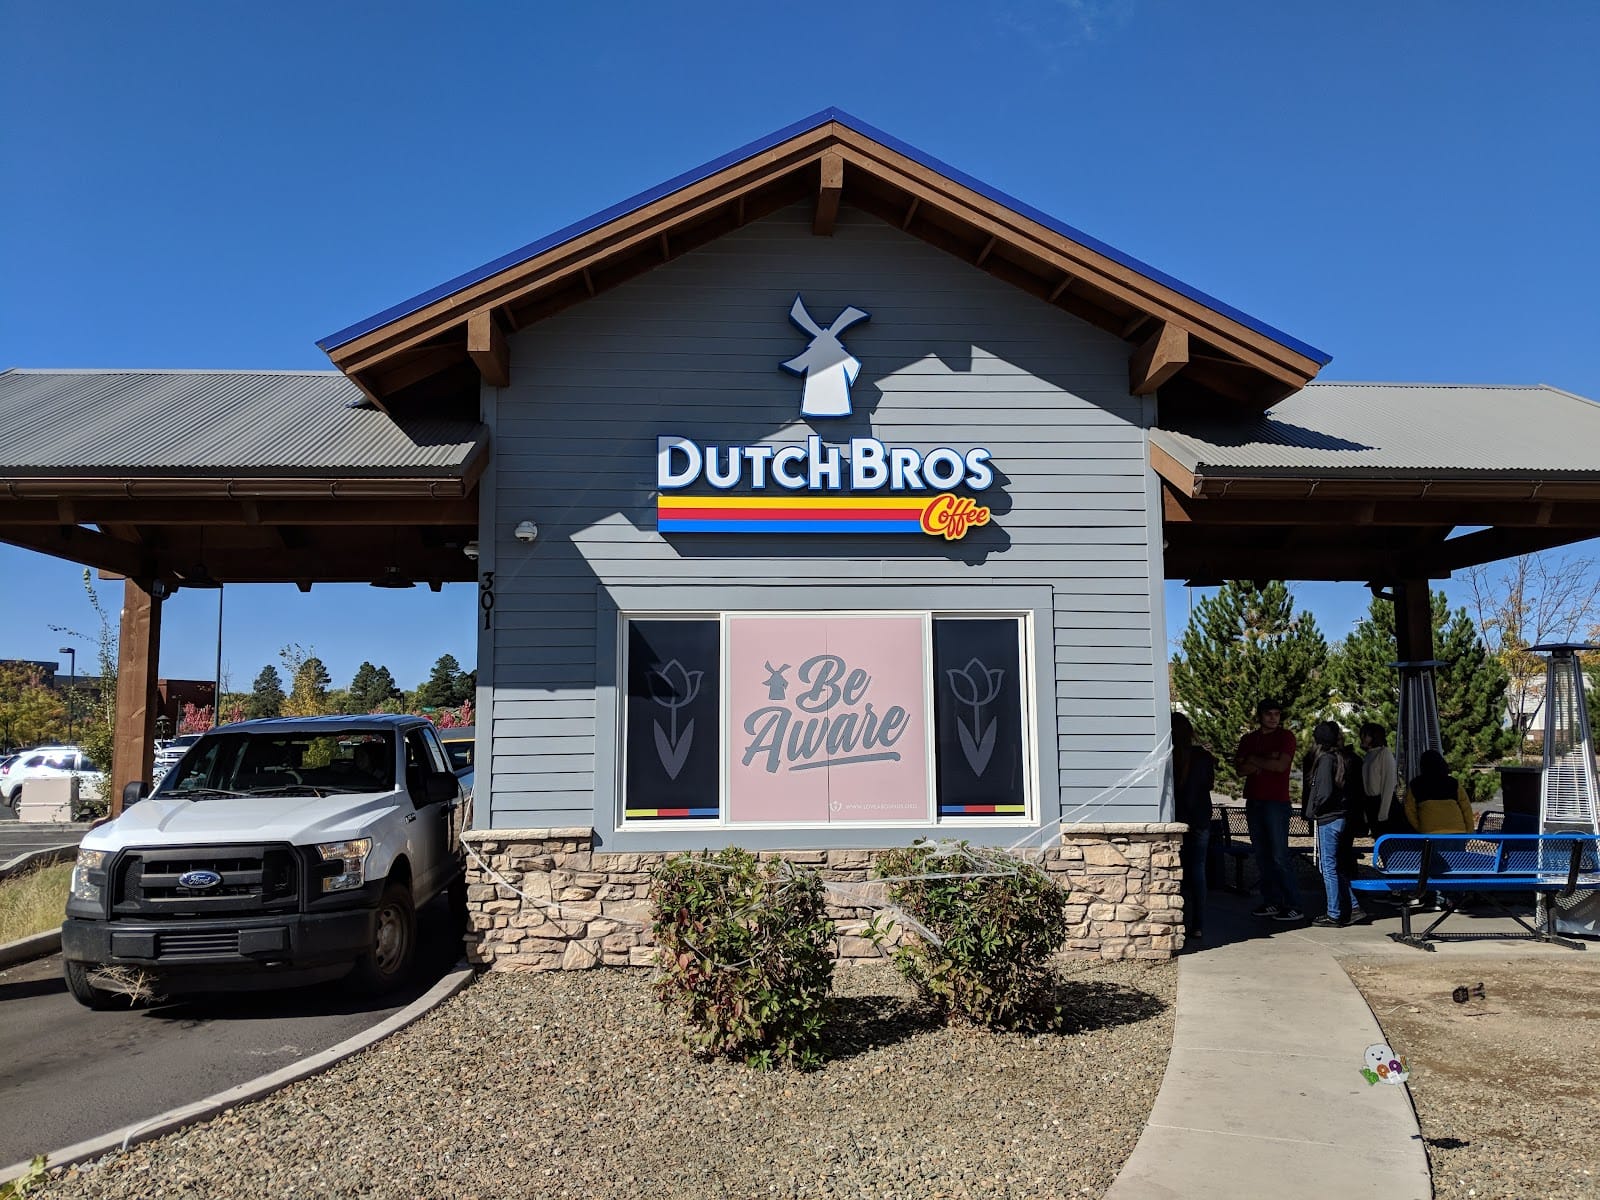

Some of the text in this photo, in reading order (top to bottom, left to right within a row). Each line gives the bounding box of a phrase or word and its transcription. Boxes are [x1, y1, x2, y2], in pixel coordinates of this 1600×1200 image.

[921, 494, 989, 538] Coffee
[480, 571, 494, 630] 301
[795, 654, 872, 714] Be
[742, 702, 911, 773] Aware
